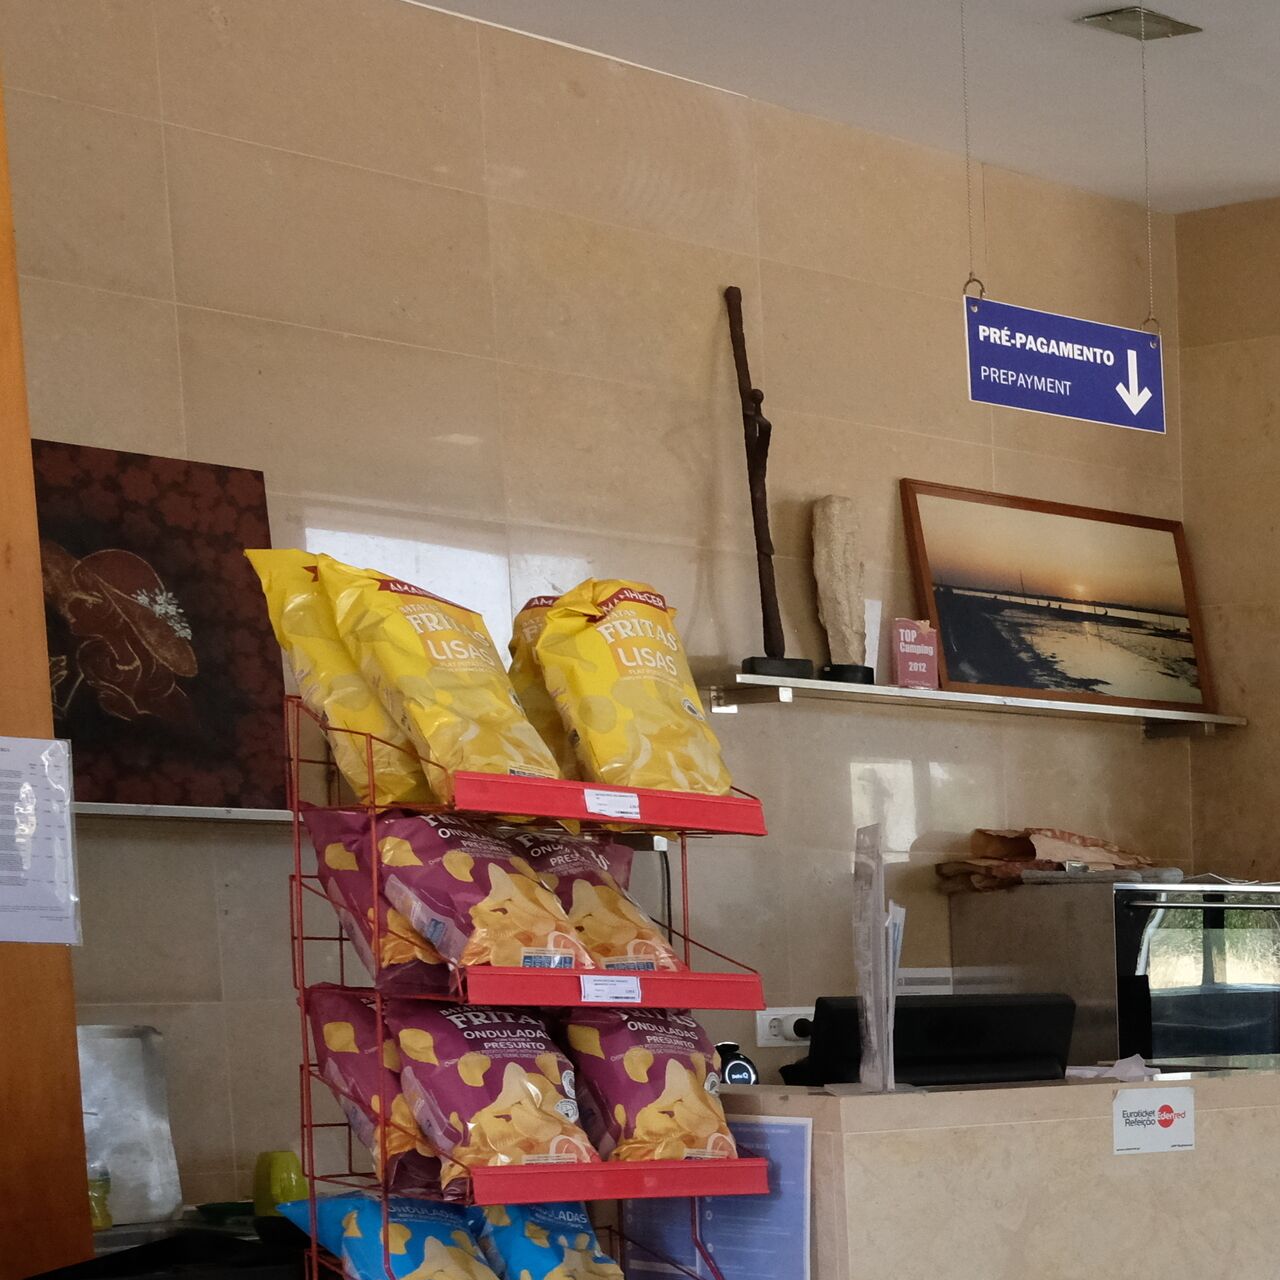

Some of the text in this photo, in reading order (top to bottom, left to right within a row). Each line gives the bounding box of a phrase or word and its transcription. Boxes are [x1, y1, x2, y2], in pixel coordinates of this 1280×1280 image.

[978, 325, 1115, 366] PRÉ-PAGAMENTO
[981, 366, 1072, 396] PREPAYMENT
[406, 612, 490, 649] FRITAS
[596, 619, 678, 652] FRITAS
[899, 629, 917, 642] TOP
[427, 639, 496, 667] LISAS
[900, 642, 934, 657] Camping
[617, 647, 678, 676] LISAS
[908, 662, 927, 673] 2012
[627, 1020, 699, 1041] ONDULADAS
[483, 1042, 546, 1051] PRESUNTO
[645, 1034, 695, 1050] PRESUNTO
[1122, 1110, 1155, 1118] Euroticket
[1125, 1117, 1156, 1127] Refeição
